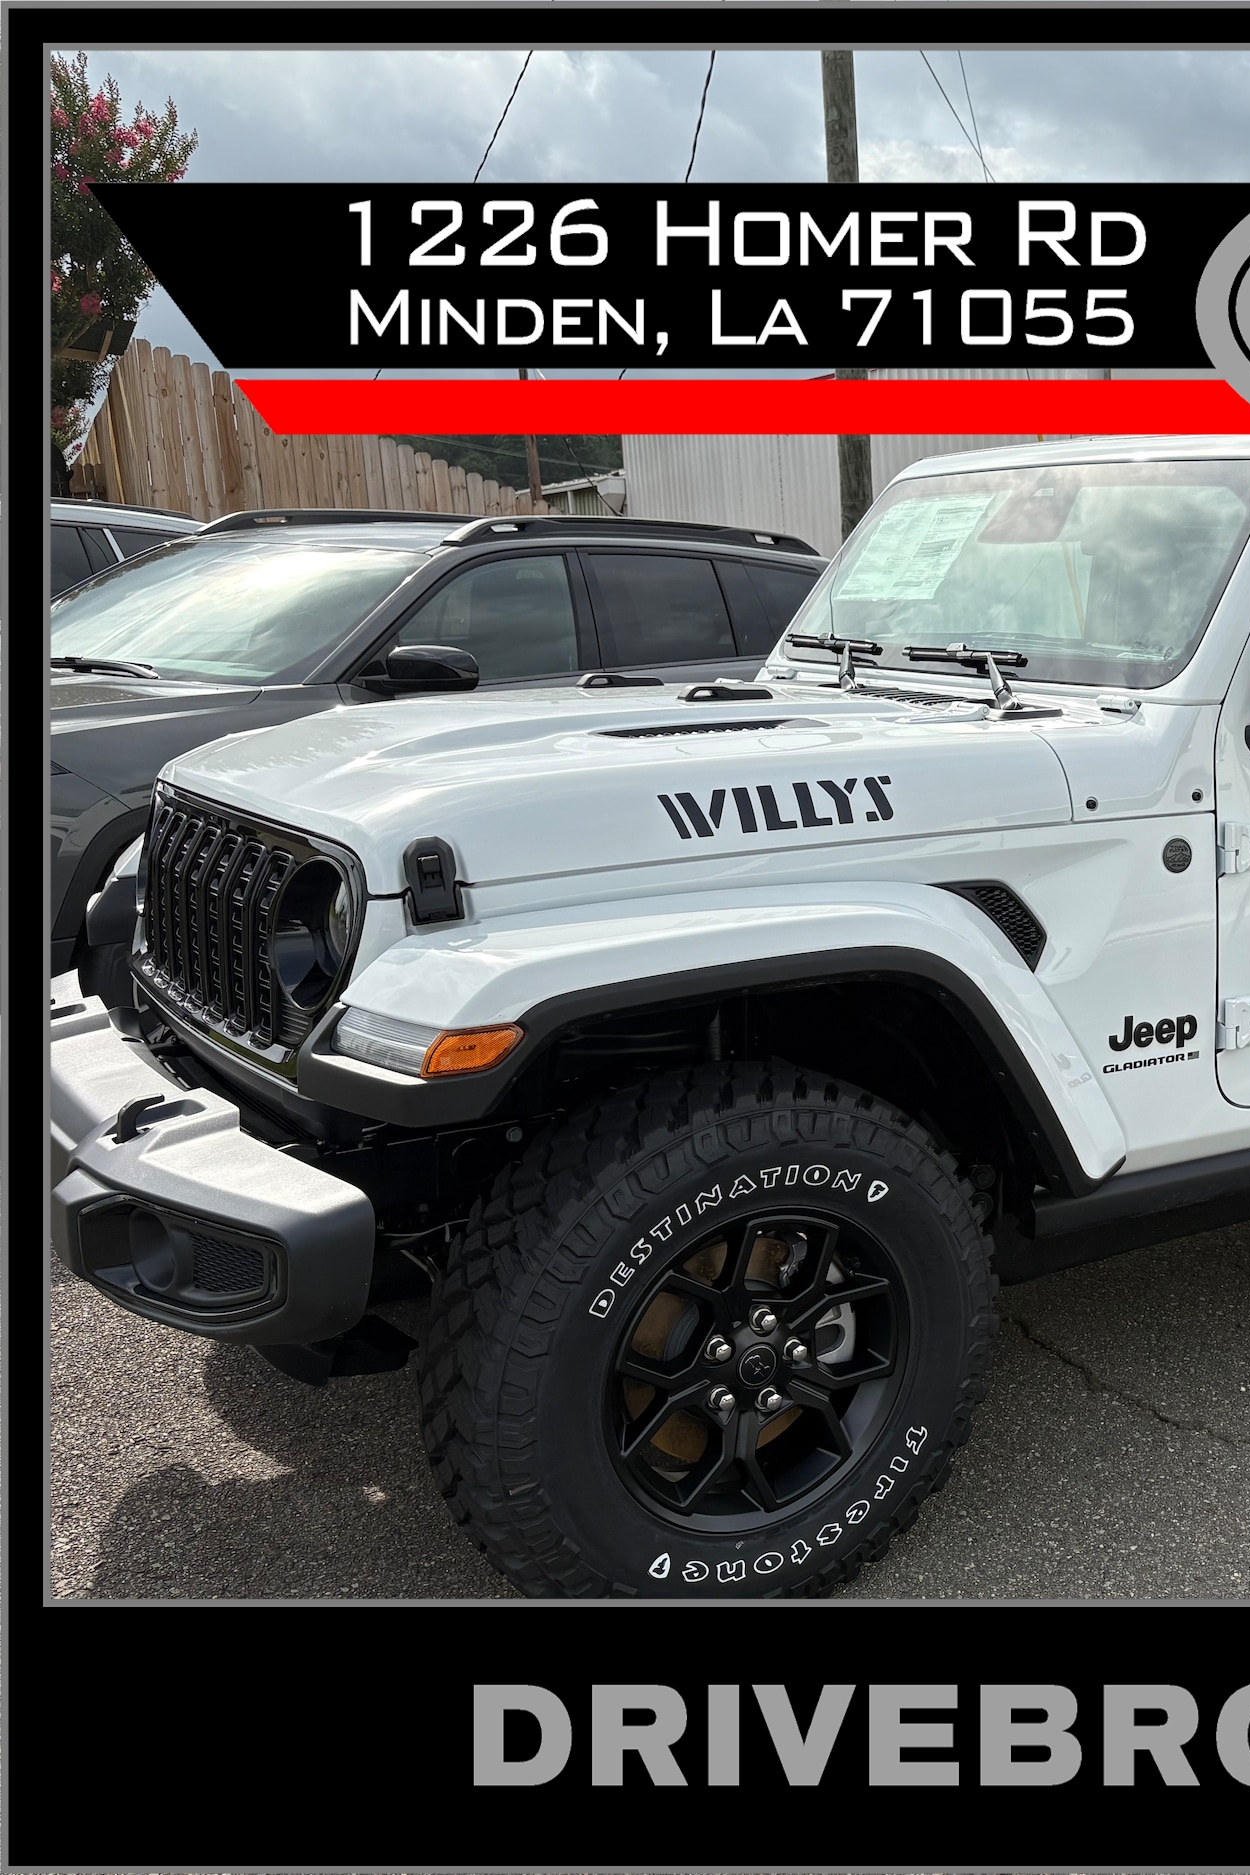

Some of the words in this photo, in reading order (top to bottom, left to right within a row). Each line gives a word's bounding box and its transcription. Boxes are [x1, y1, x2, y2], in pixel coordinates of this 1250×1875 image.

[656, 775, 894, 840] WILLYS
[1108, 1014, 1198, 1051] Jeep
[1102, 1052, 1186, 1074] GLADIATOR
[588, 1164, 862, 1319] DESTINATION
